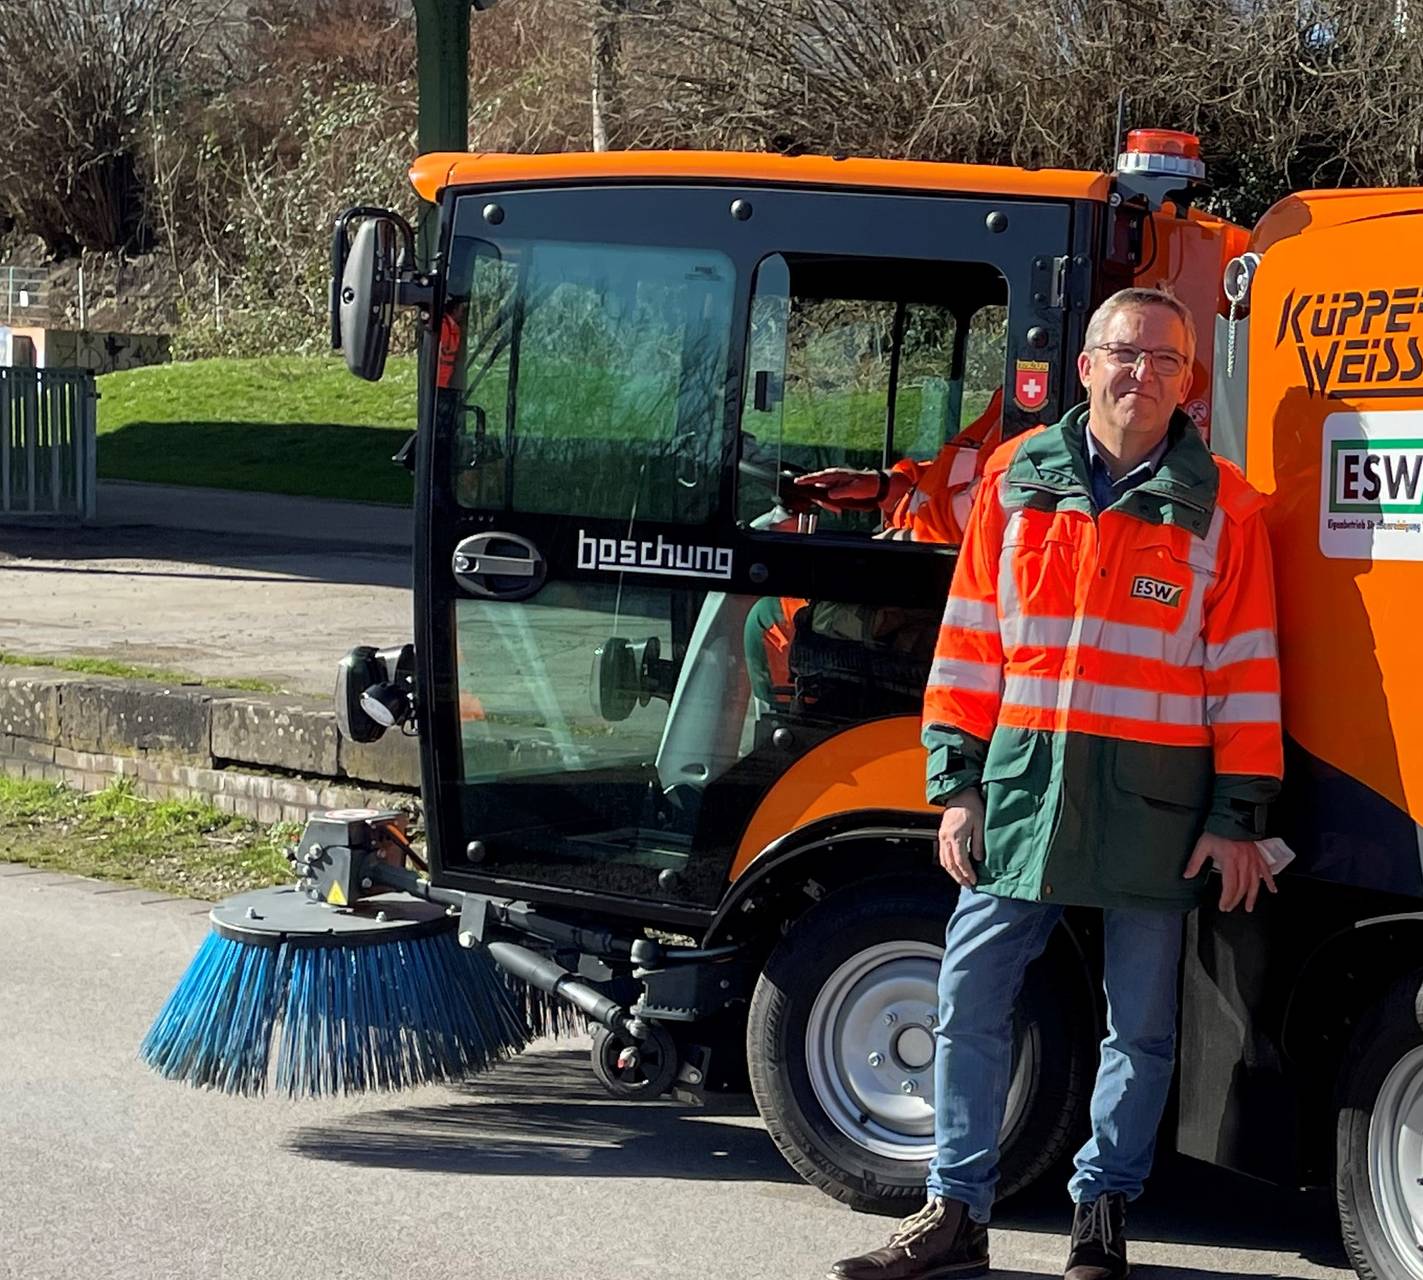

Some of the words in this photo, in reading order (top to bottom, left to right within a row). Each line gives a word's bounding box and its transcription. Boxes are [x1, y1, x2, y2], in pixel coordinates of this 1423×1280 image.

[1343, 454, 1423, 501] ESW
[577, 529, 733, 579] boschung
[1136, 580, 1173, 600] ESW
